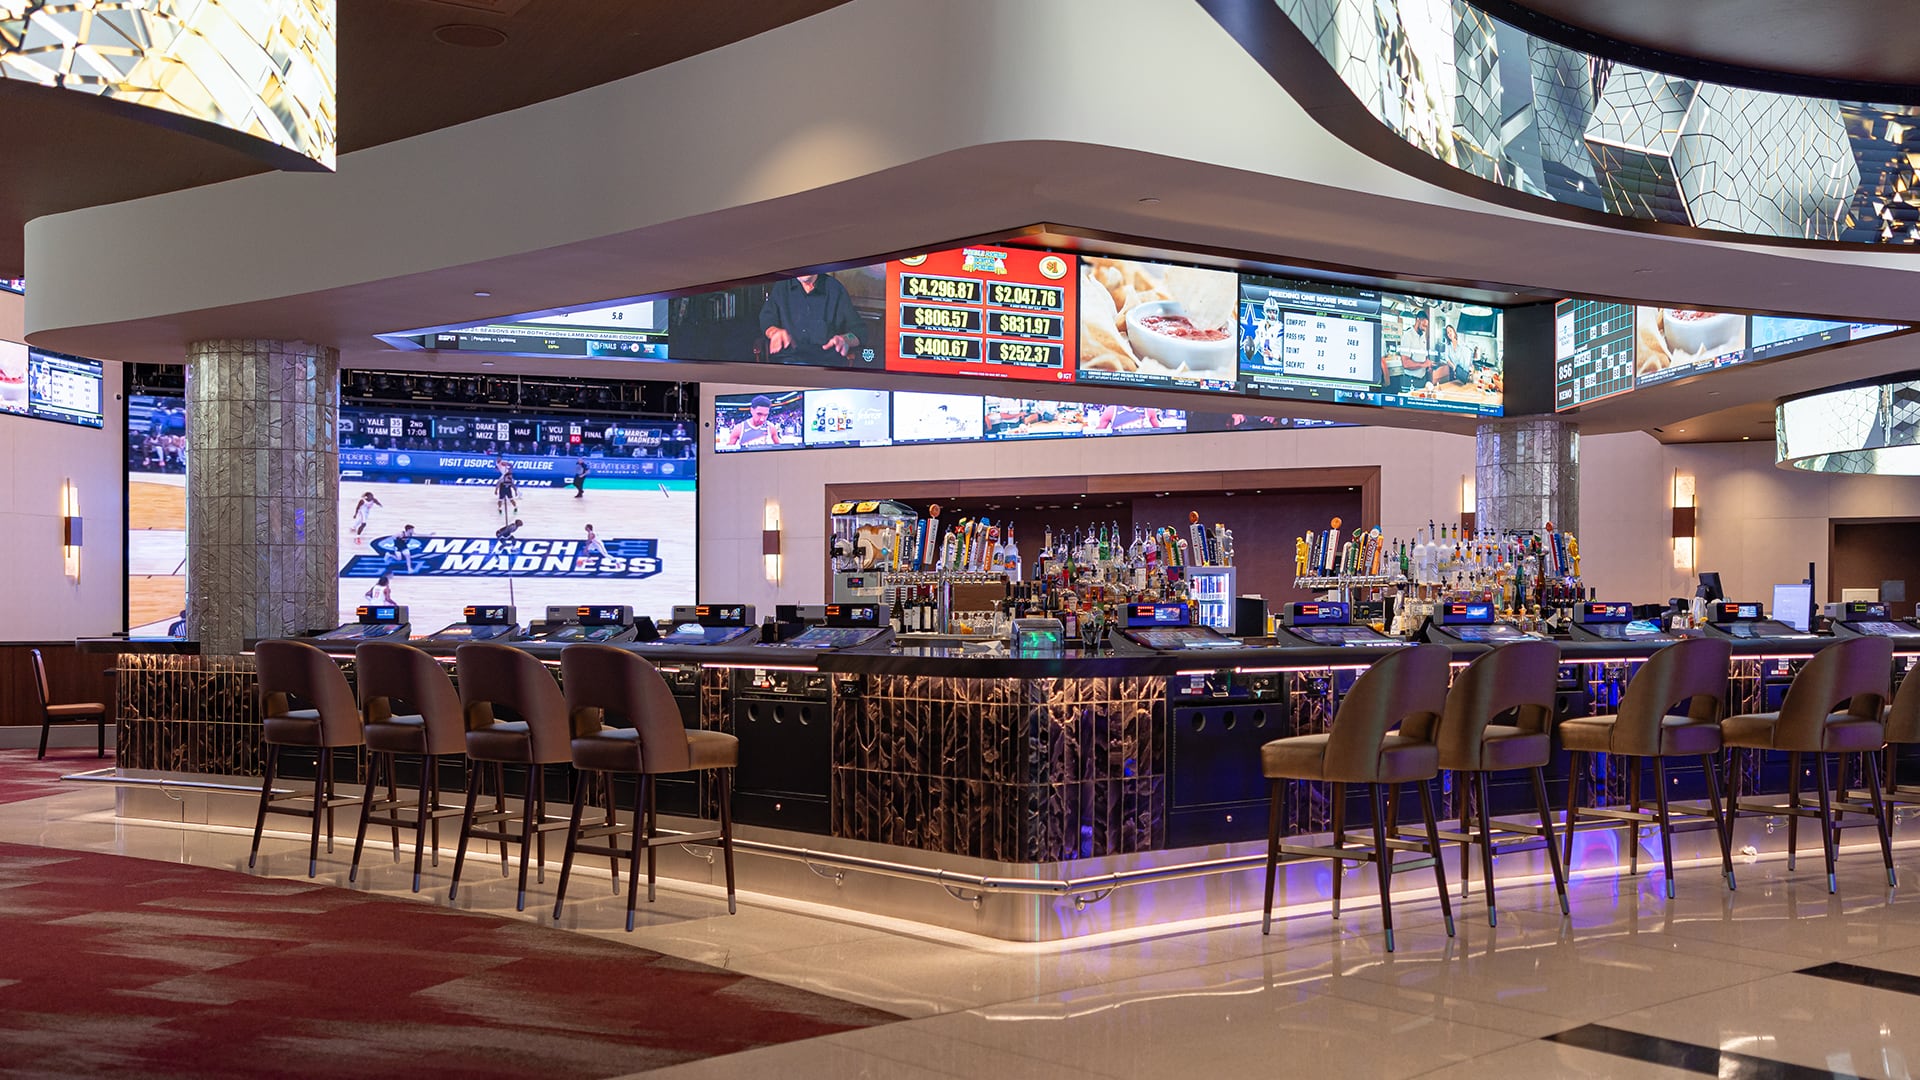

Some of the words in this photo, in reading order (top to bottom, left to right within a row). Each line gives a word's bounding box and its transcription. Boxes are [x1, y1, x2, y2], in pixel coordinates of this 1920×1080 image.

[1269, 290, 1300, 300] NEEDING
[1301, 294, 1316, 302] ONE
[1317, 296, 1337, 304] MORE
[1338, 298, 1358, 307] PIECE
[612, 312, 624, 321] 5.8
[915, 307, 968, 328] $806.57
[1000, 314, 1050, 335] $831.97
[914, 336, 968, 357] $400.67
[1000, 343, 1050, 363] $252.37
[1558, 363, 1572, 380] 856
[367, 418, 384, 426] YALE
[476, 424, 496, 432] DRAKE
[391, 428, 402, 436] 45
[408, 428, 426, 436] 17:08
[514, 428, 531, 436] HALF
[625, 430, 648, 438] MARCH
[627, 436, 660, 444] MADNESS
[440, 458, 462, 467] VISIT
[464, 458, 554, 470] USOPC./COLLEGE
[423, 539, 578, 555] MARCH
[441, 554, 658, 573] MADNESS
